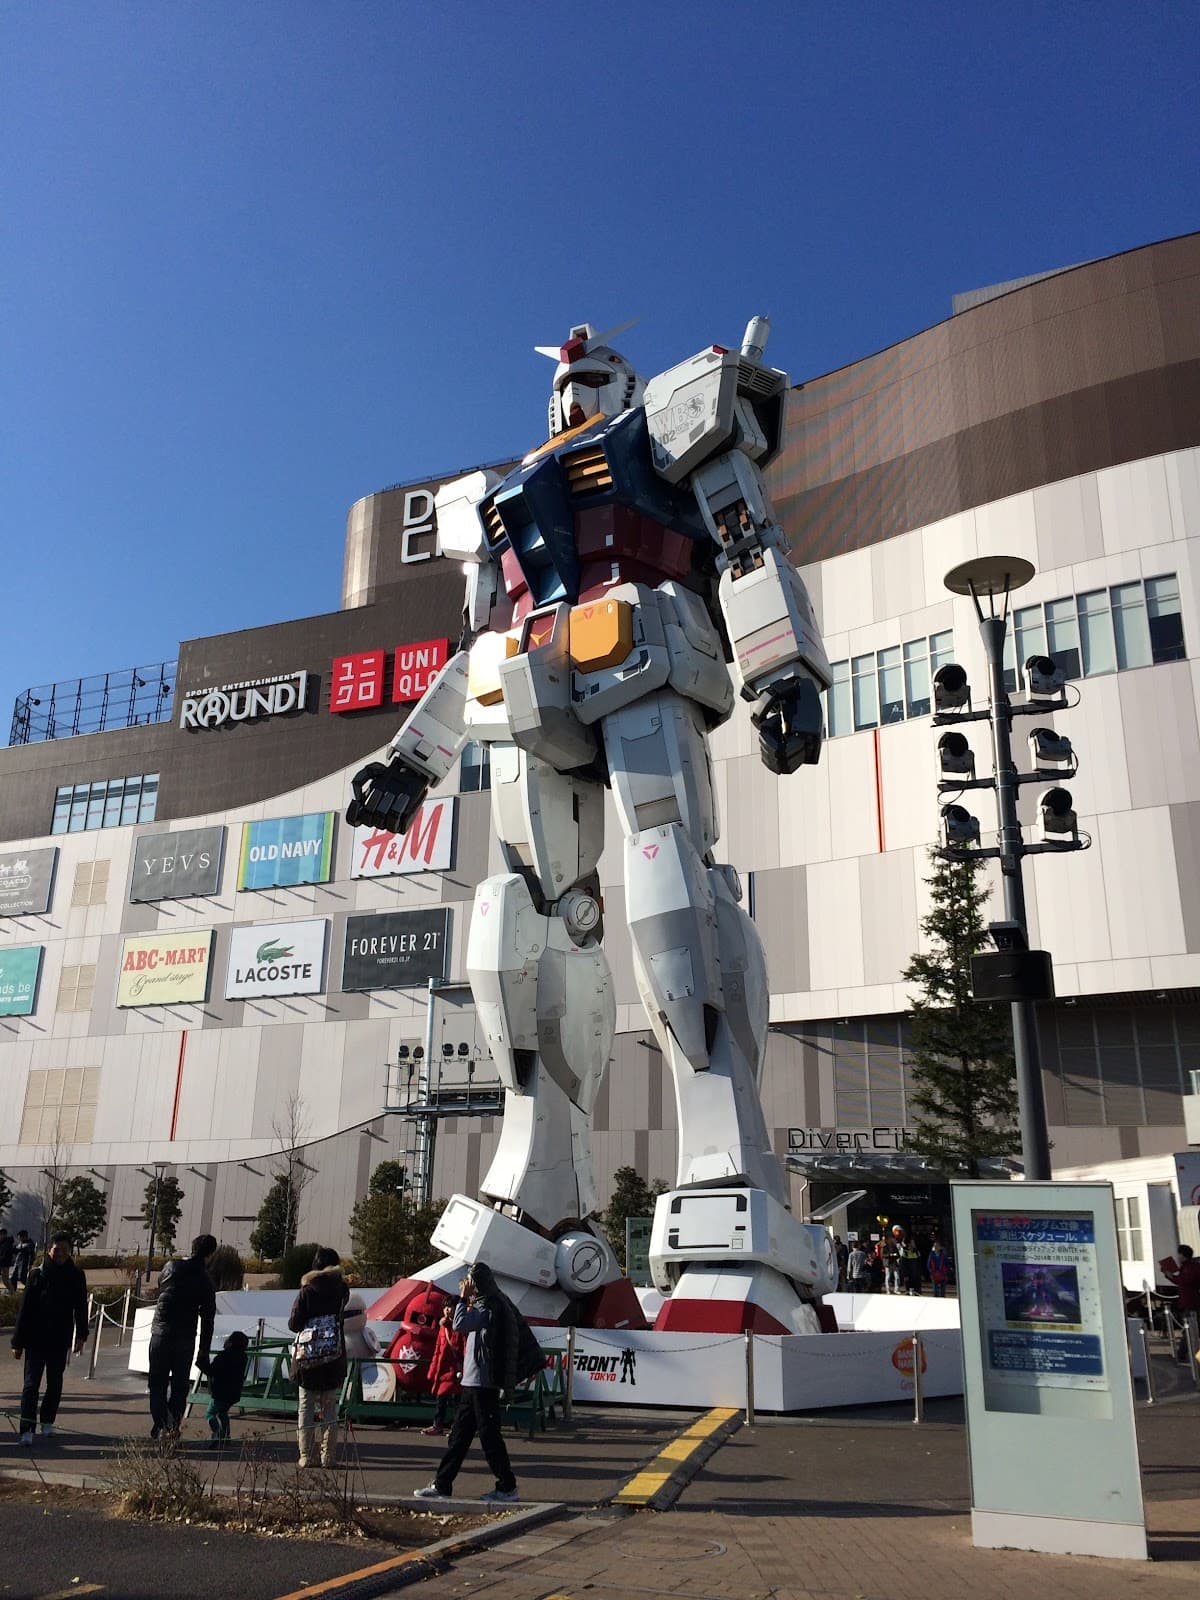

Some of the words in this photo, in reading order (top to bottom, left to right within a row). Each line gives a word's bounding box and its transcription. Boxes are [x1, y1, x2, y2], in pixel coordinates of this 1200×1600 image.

[401, 647, 438, 671] UNI
[185, 686, 219, 698] SPORTS
[221, 673, 298, 691] ENTERTAINMENT
[361, 803, 444, 870] H&M
[249, 846, 279, 863] OLD
[280, 839, 322, 859] NAVY
[143, 852, 211, 876] YEVS
[351, 934, 417, 957] FOREVER
[123, 947, 207, 972] ABC-MART
[235, 963, 313, 984] LACOSTE
[589, 1372, 617, 1382] TOKYO
